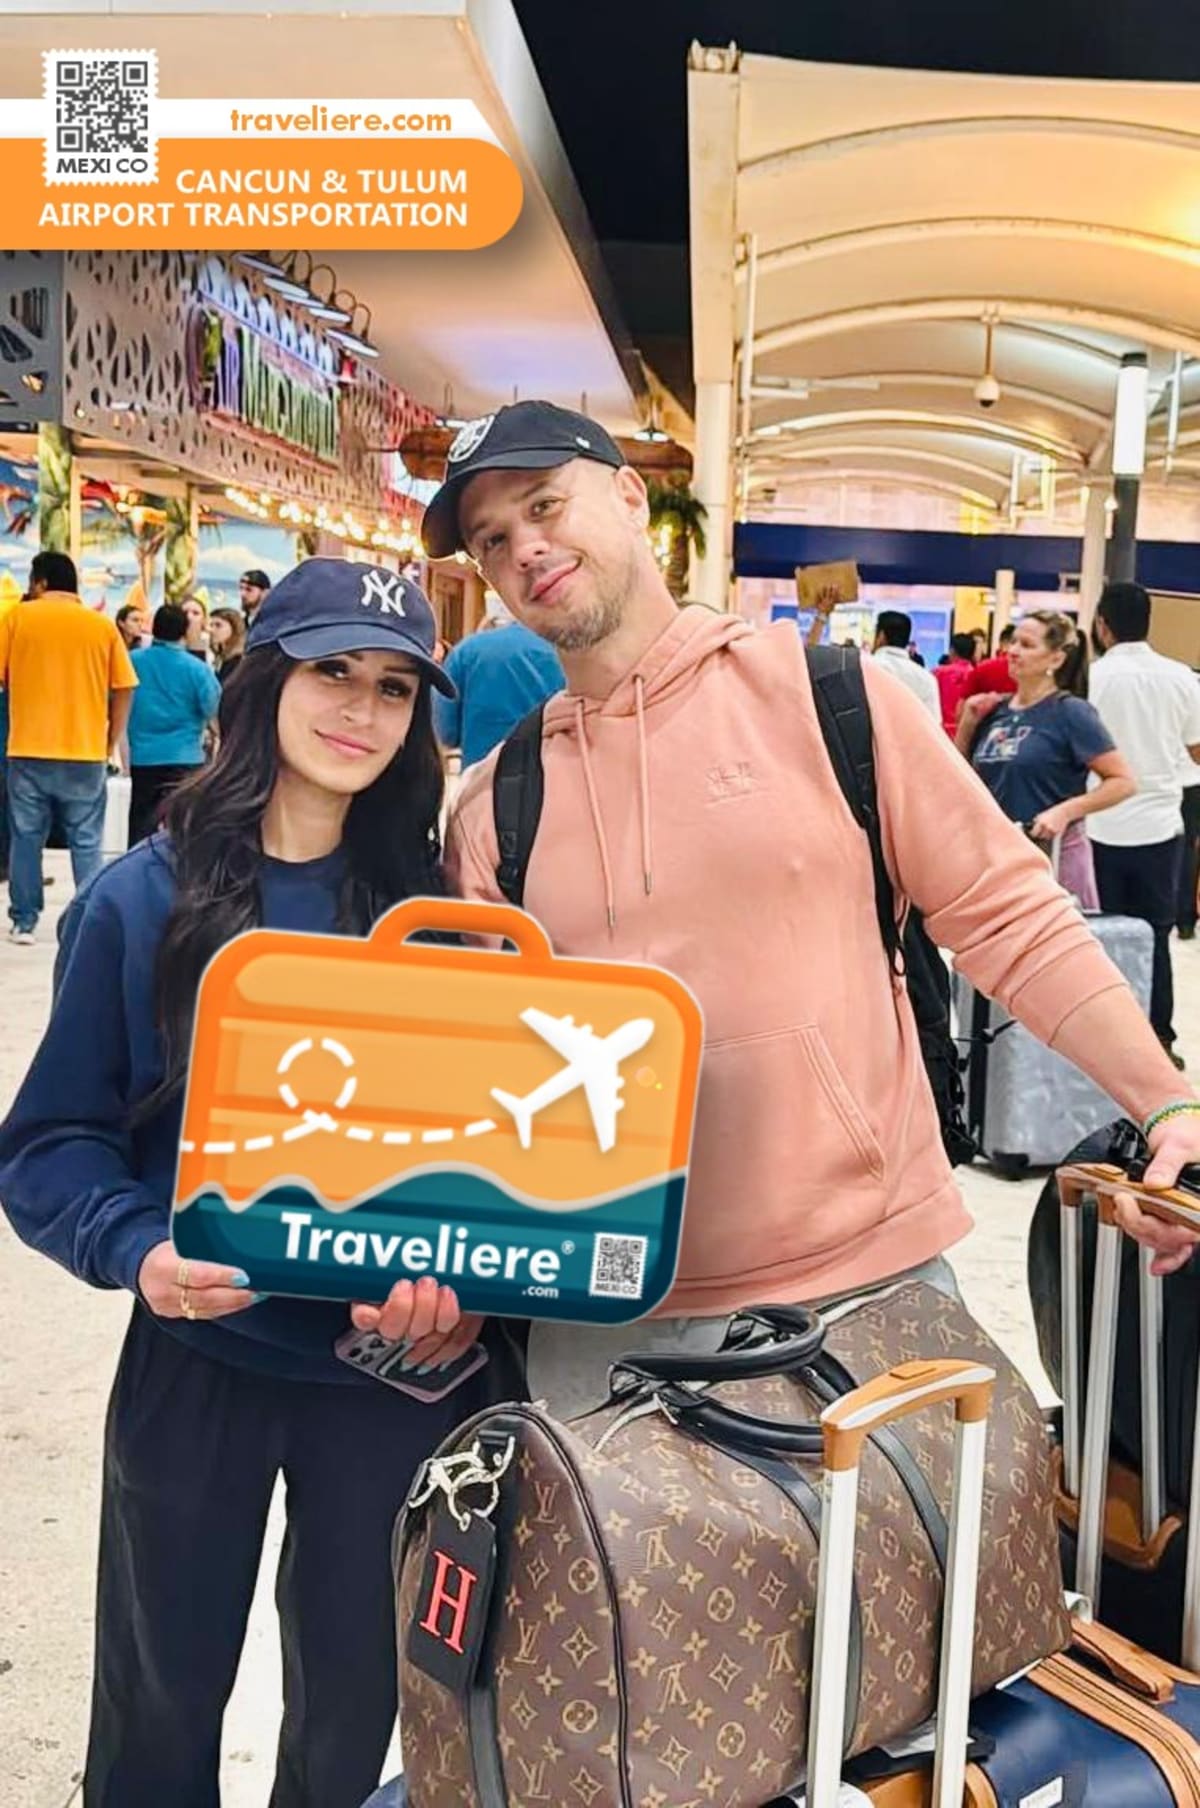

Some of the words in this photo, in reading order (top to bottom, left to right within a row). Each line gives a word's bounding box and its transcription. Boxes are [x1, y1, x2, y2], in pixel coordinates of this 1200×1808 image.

[361, 569, 406, 617] NY
[522, 1286, 559, 1299] .com
[419, 1550, 478, 1654] H
